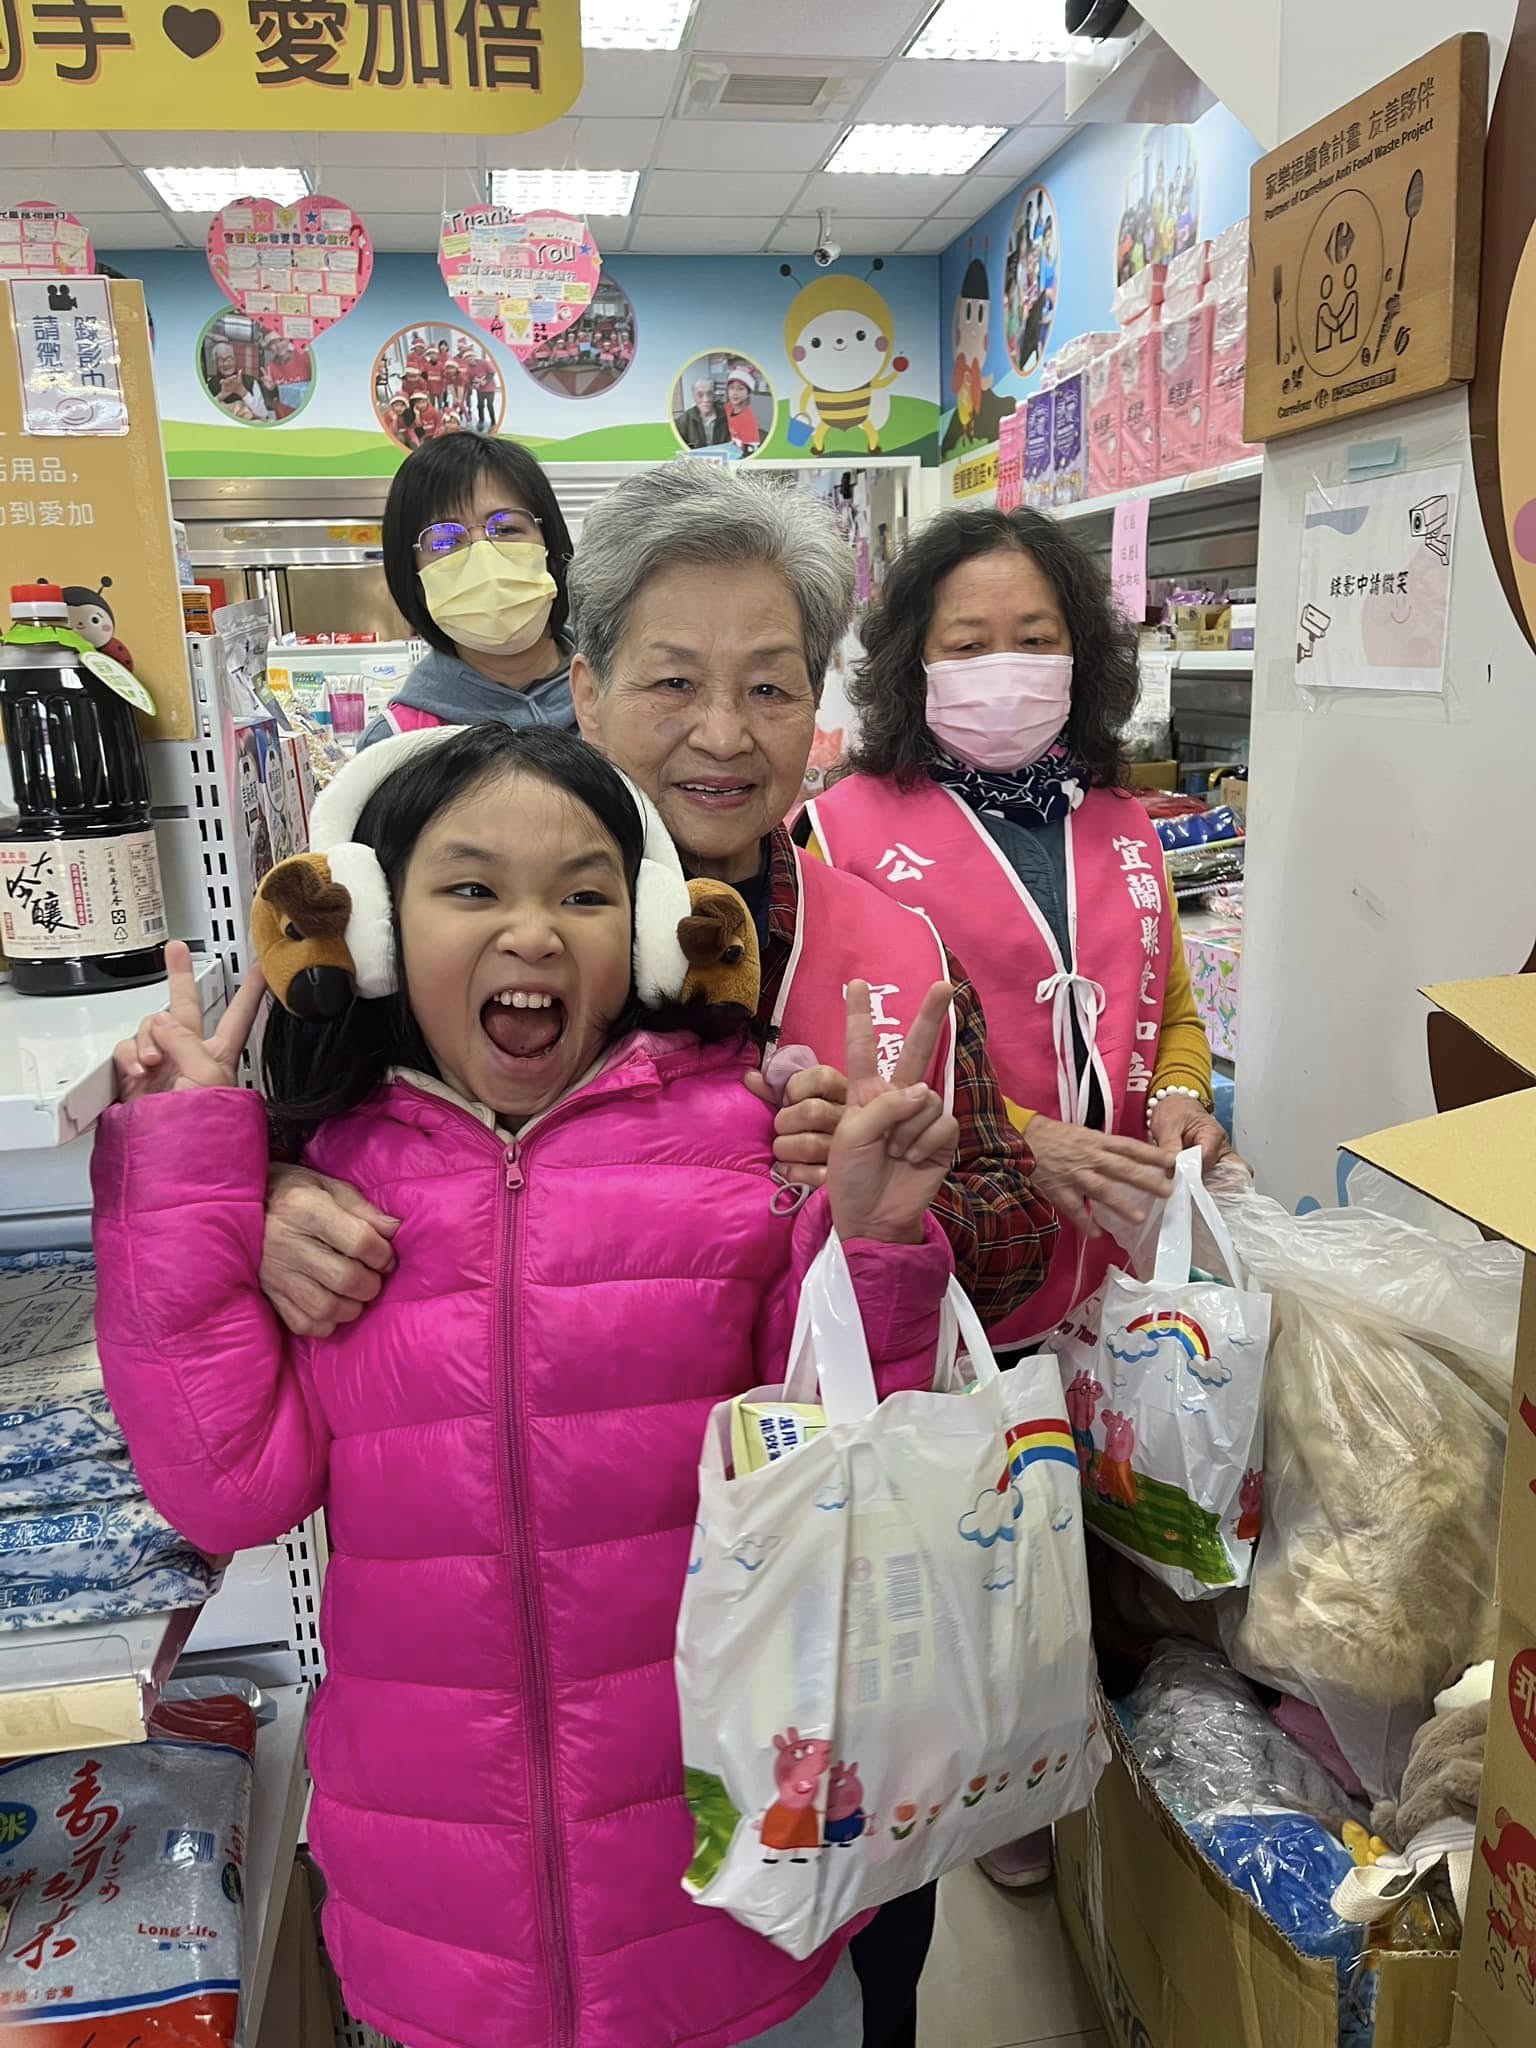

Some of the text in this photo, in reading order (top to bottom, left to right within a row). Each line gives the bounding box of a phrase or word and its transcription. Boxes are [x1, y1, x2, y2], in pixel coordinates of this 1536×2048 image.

[248, 0, 543, 90] 愛加倍
[1368, 76, 1435, 141] 友善夥伴
[1264, 199, 1290, 222] Partner
[1299, 175, 1335, 204] Carrefour
[1334, 160, 1352, 182] Anti
[1352, 149, 1374, 172] Food
[1373, 137, 1401, 161] Waste
[1400, 117, 1434, 147] Project
[449, 205, 514, 233] Thank
[32, 314, 66, 388] 請微
[0, 500, 95, 527] 到愛加
[1329, 570, 1409, 597] 錄影中請微笑
[875, 843, 936, 882] 公
[138, 1922, 182, 1939] Long
